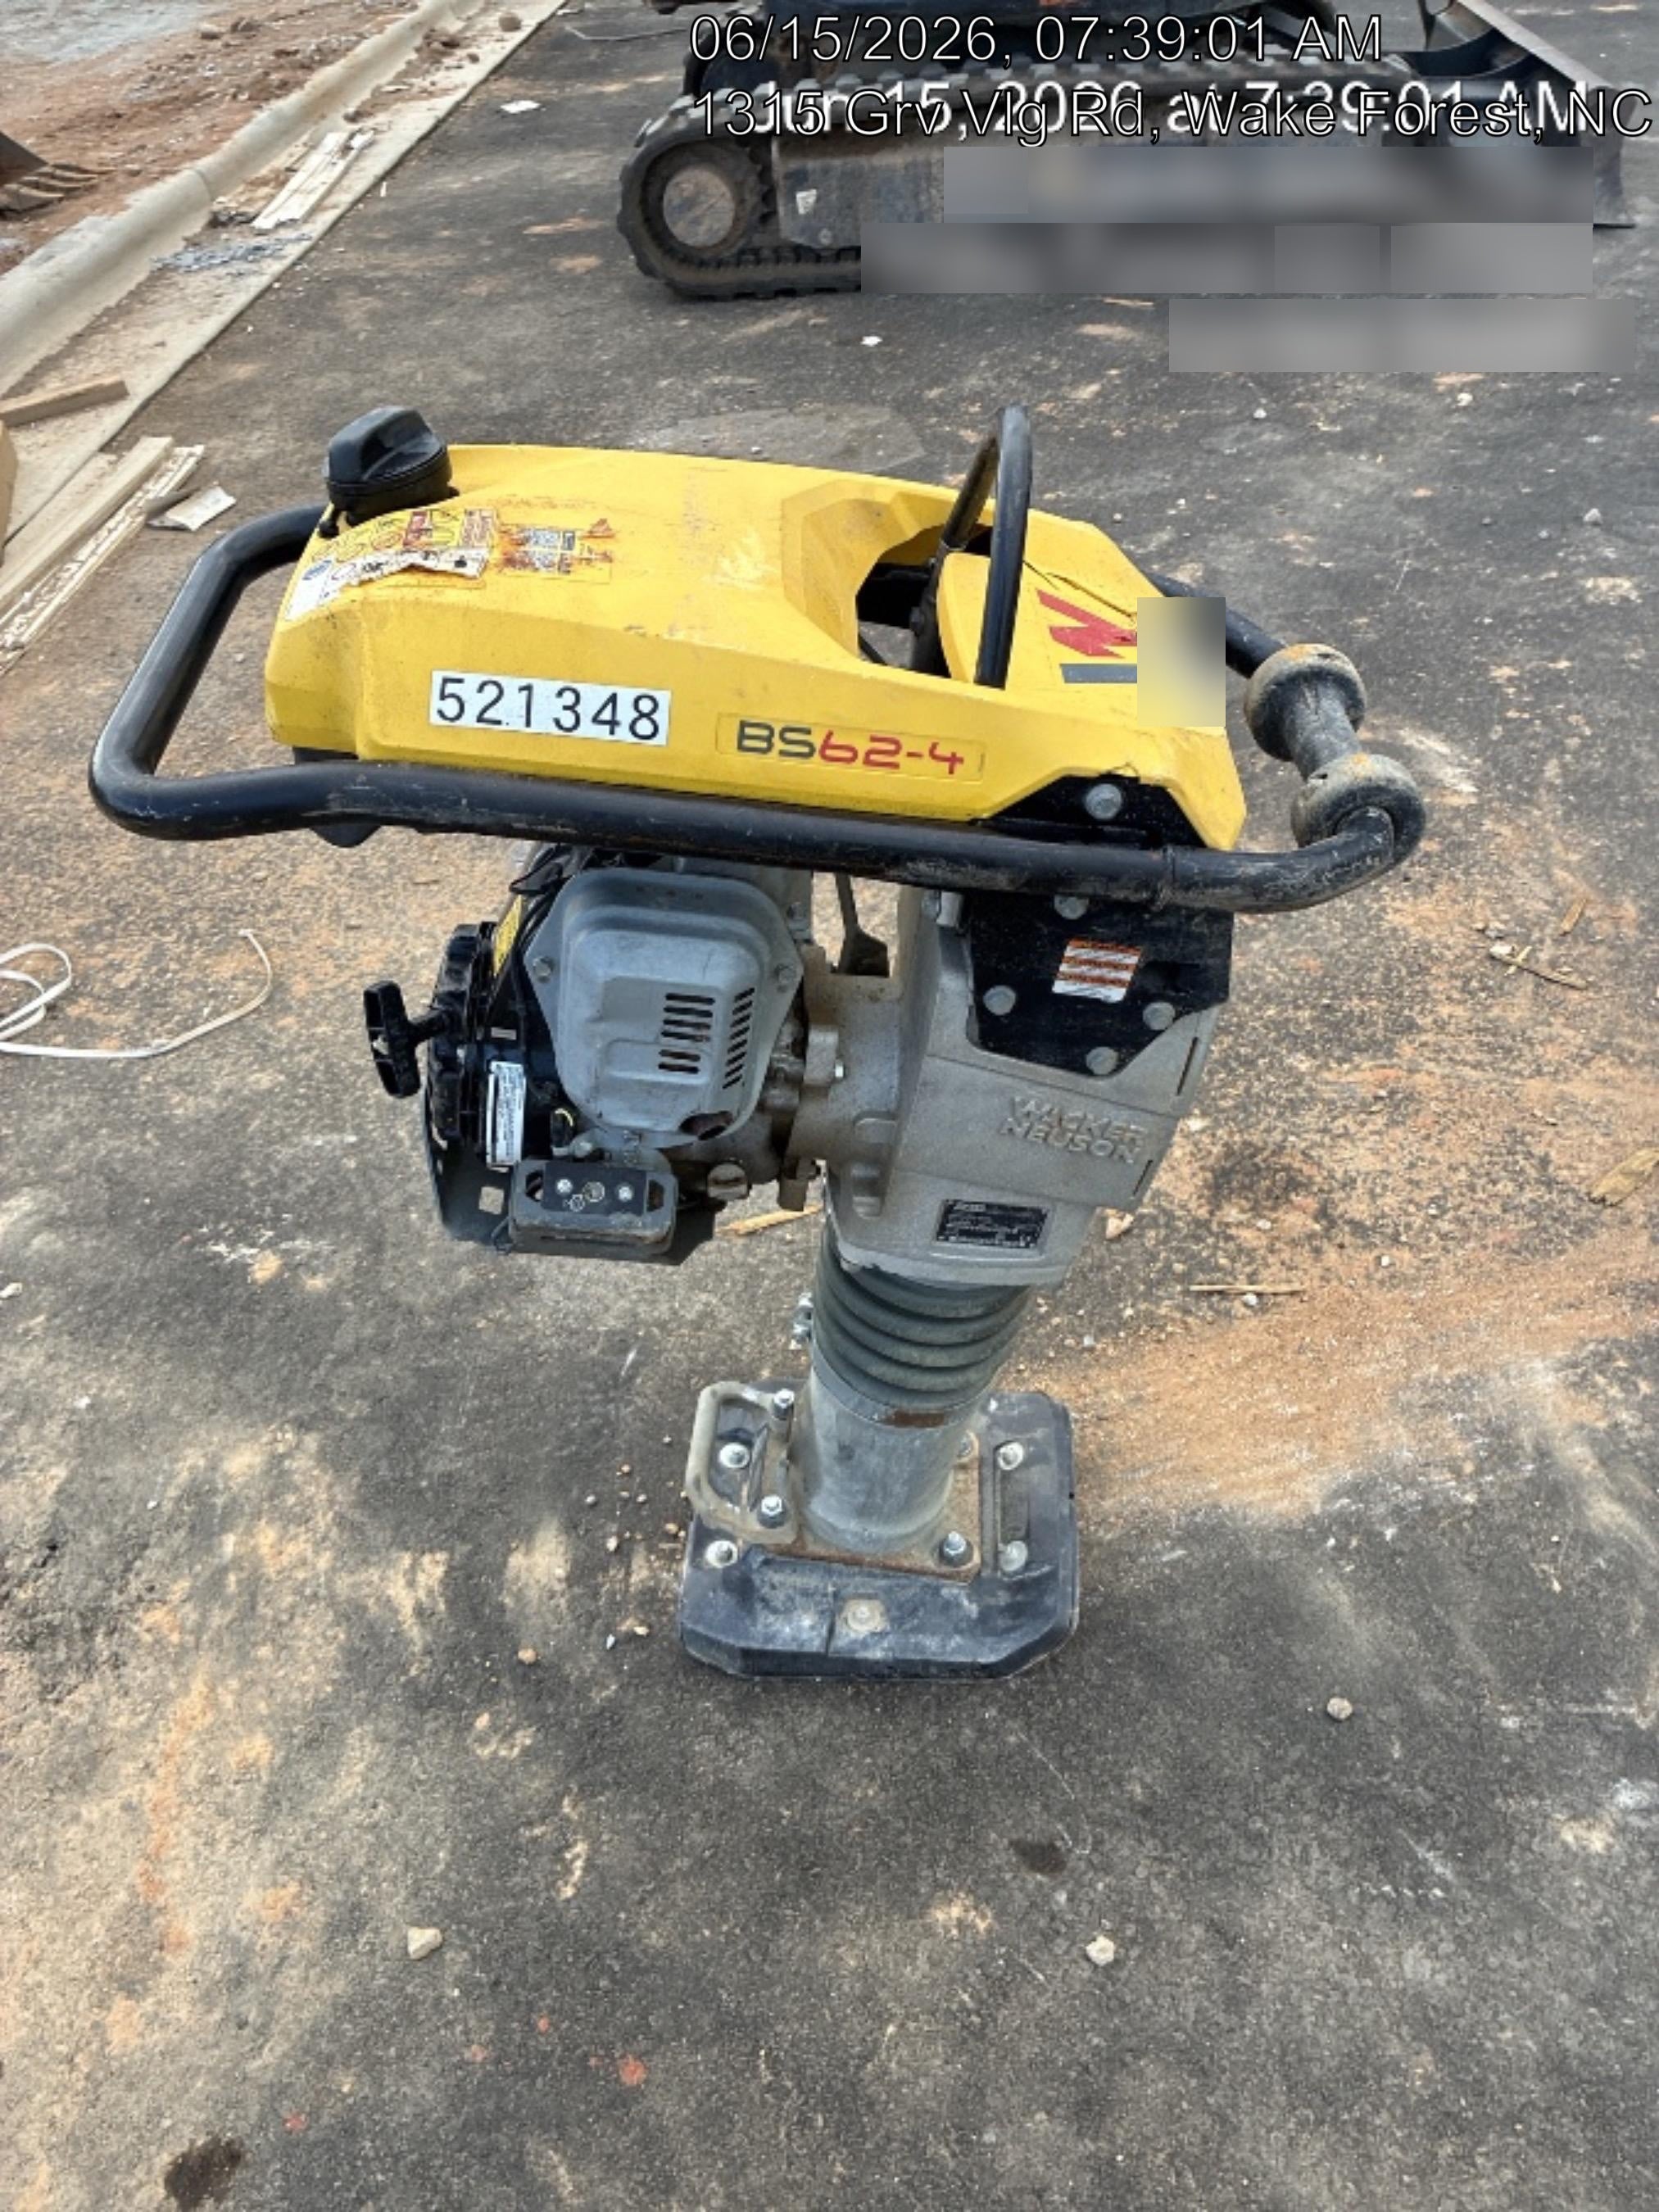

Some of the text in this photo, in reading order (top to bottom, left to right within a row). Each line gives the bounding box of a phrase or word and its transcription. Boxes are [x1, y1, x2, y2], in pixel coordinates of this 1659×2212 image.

[435, 676, 661, 741] 521348
[737, 718, 965, 775] BS62-4
[999, 1116, 1142, 1165] NEUSON
